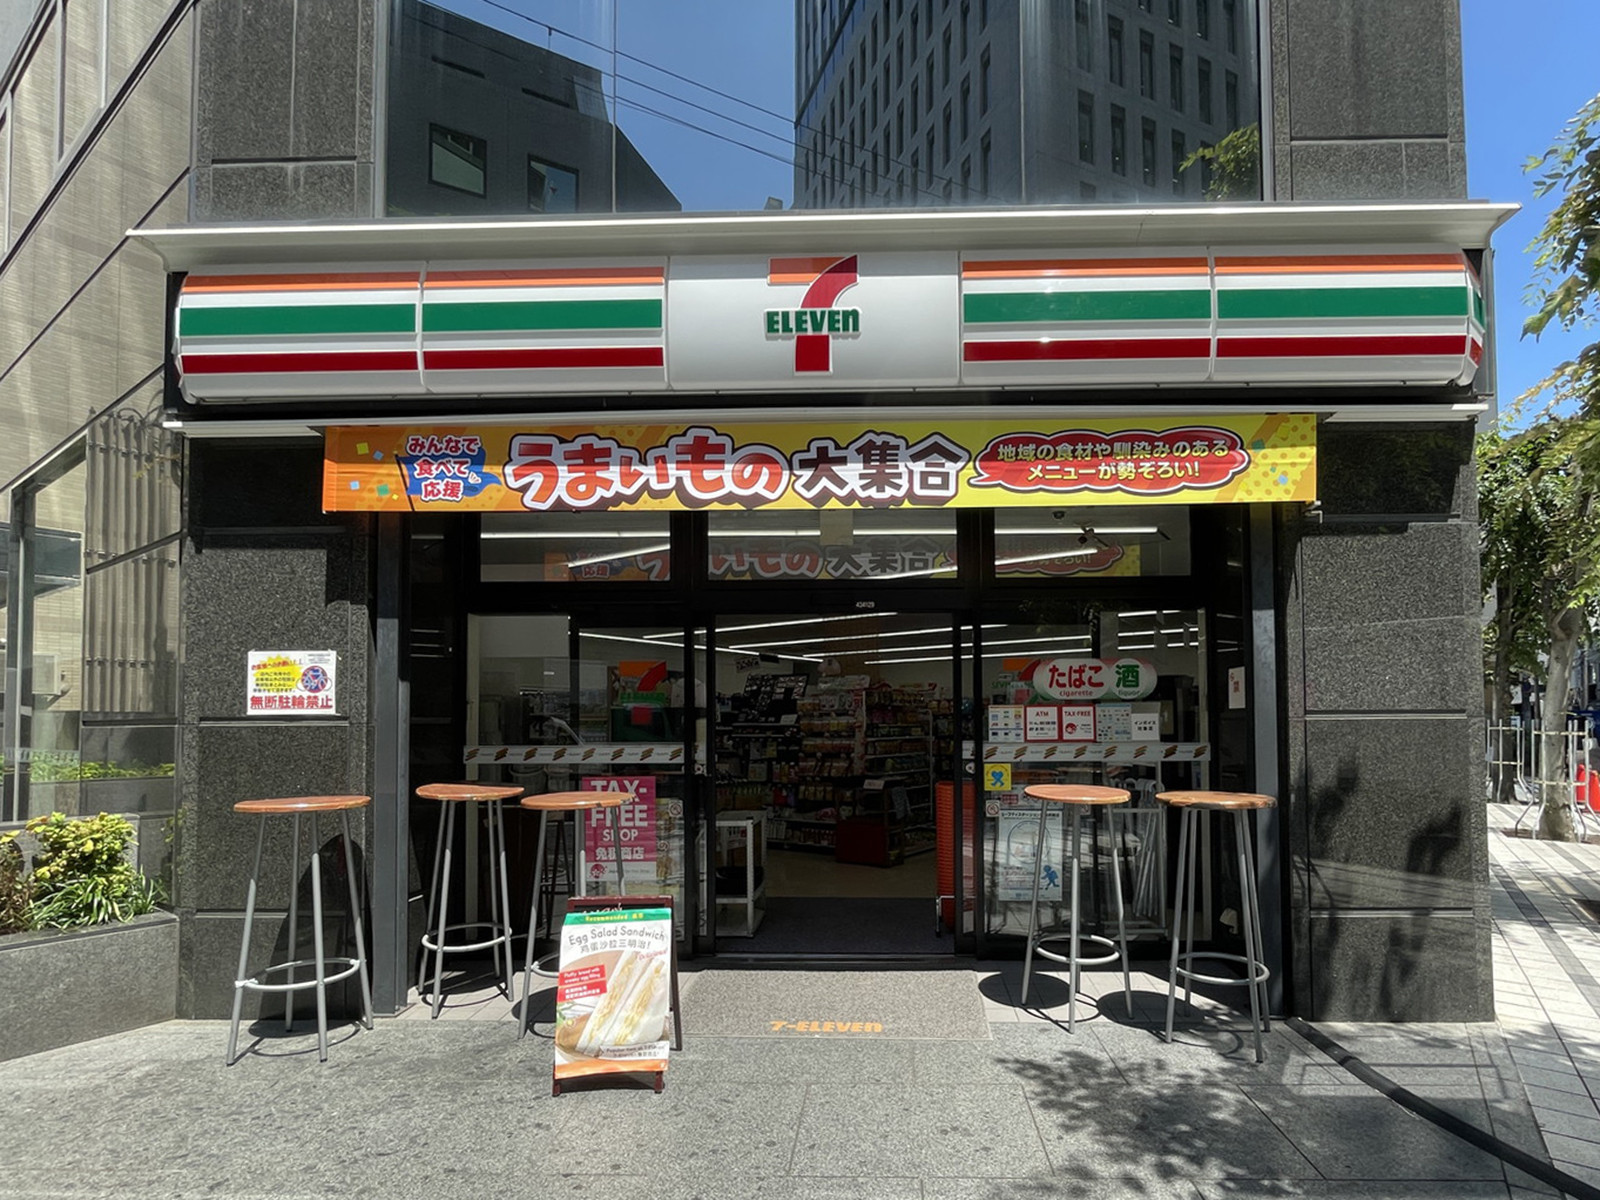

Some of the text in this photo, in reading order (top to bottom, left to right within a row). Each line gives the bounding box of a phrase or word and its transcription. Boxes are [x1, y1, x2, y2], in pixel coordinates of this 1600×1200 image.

[407, 436, 480, 456] みんなで
[998, 439, 1229, 461] 地域の食材や馴染みのある
[414, 458, 471, 480] 食べて
[1027, 460, 1200, 482] メニューが勢ぞろい!
[420, 480, 464, 502] 応援
[1048, 664, 1140, 689] たばこ 酒
[250, 696, 333, 709] 無断駐輪禁止
[1059, 688, 1094, 698] cigarette
[568, 925, 665, 946] Egg Salad Sandwich
